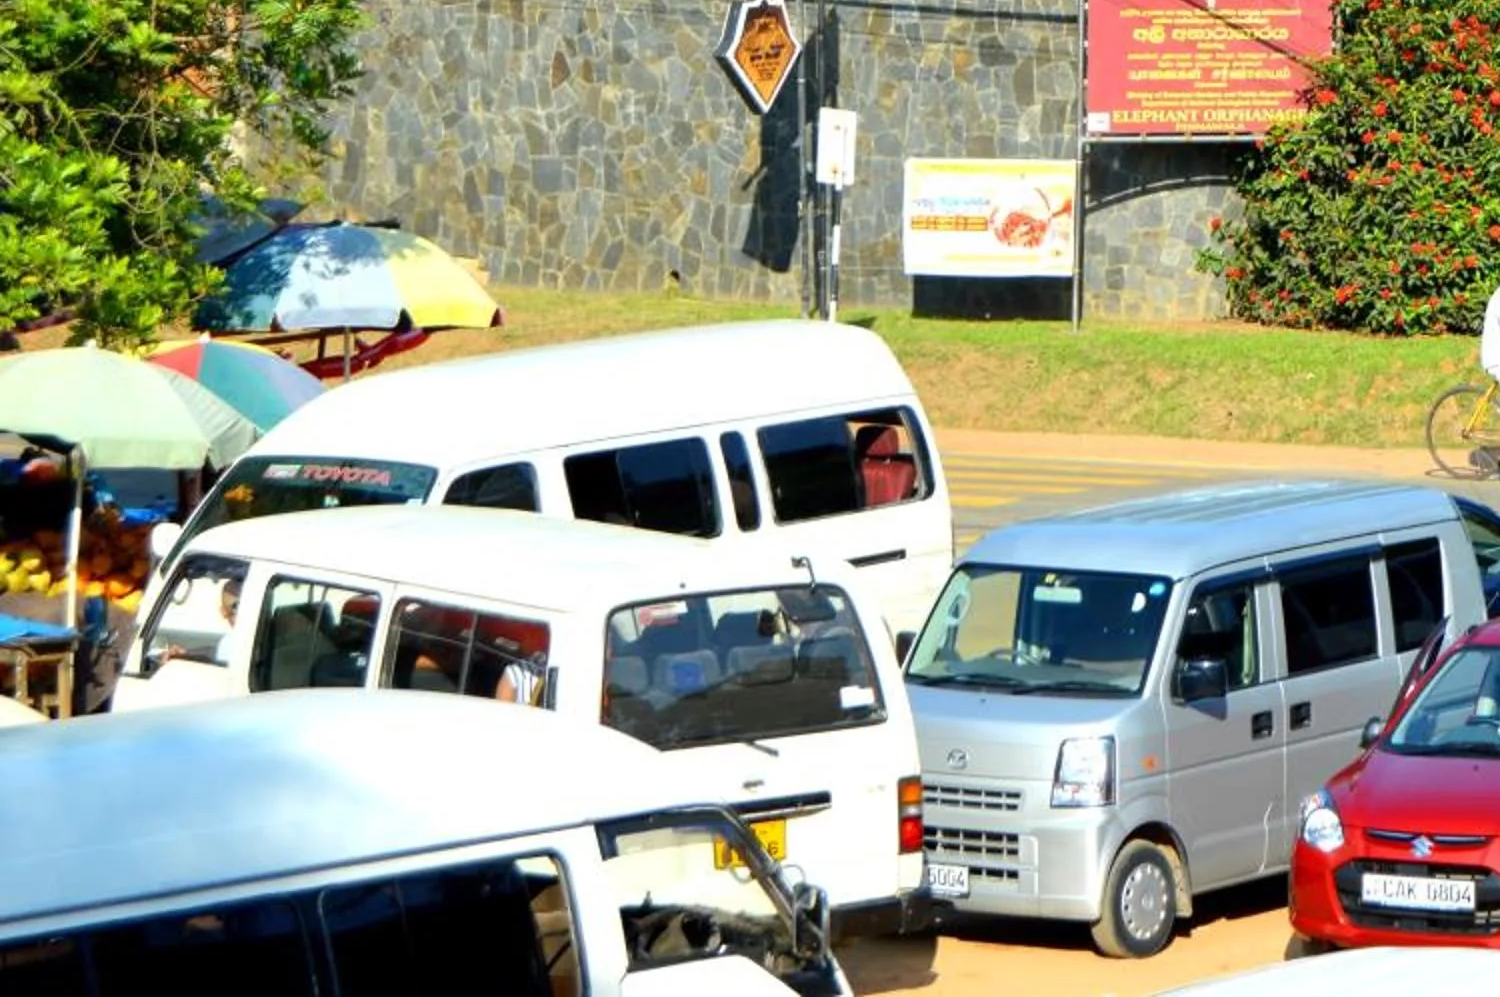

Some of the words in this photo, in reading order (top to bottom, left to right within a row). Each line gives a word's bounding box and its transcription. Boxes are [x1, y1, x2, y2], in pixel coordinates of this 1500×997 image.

[1112, 110, 1198, 123] ELEPHANT
[303, 464, 392, 486] TOYOTA
[1382, 879, 1417, 900] CAK
